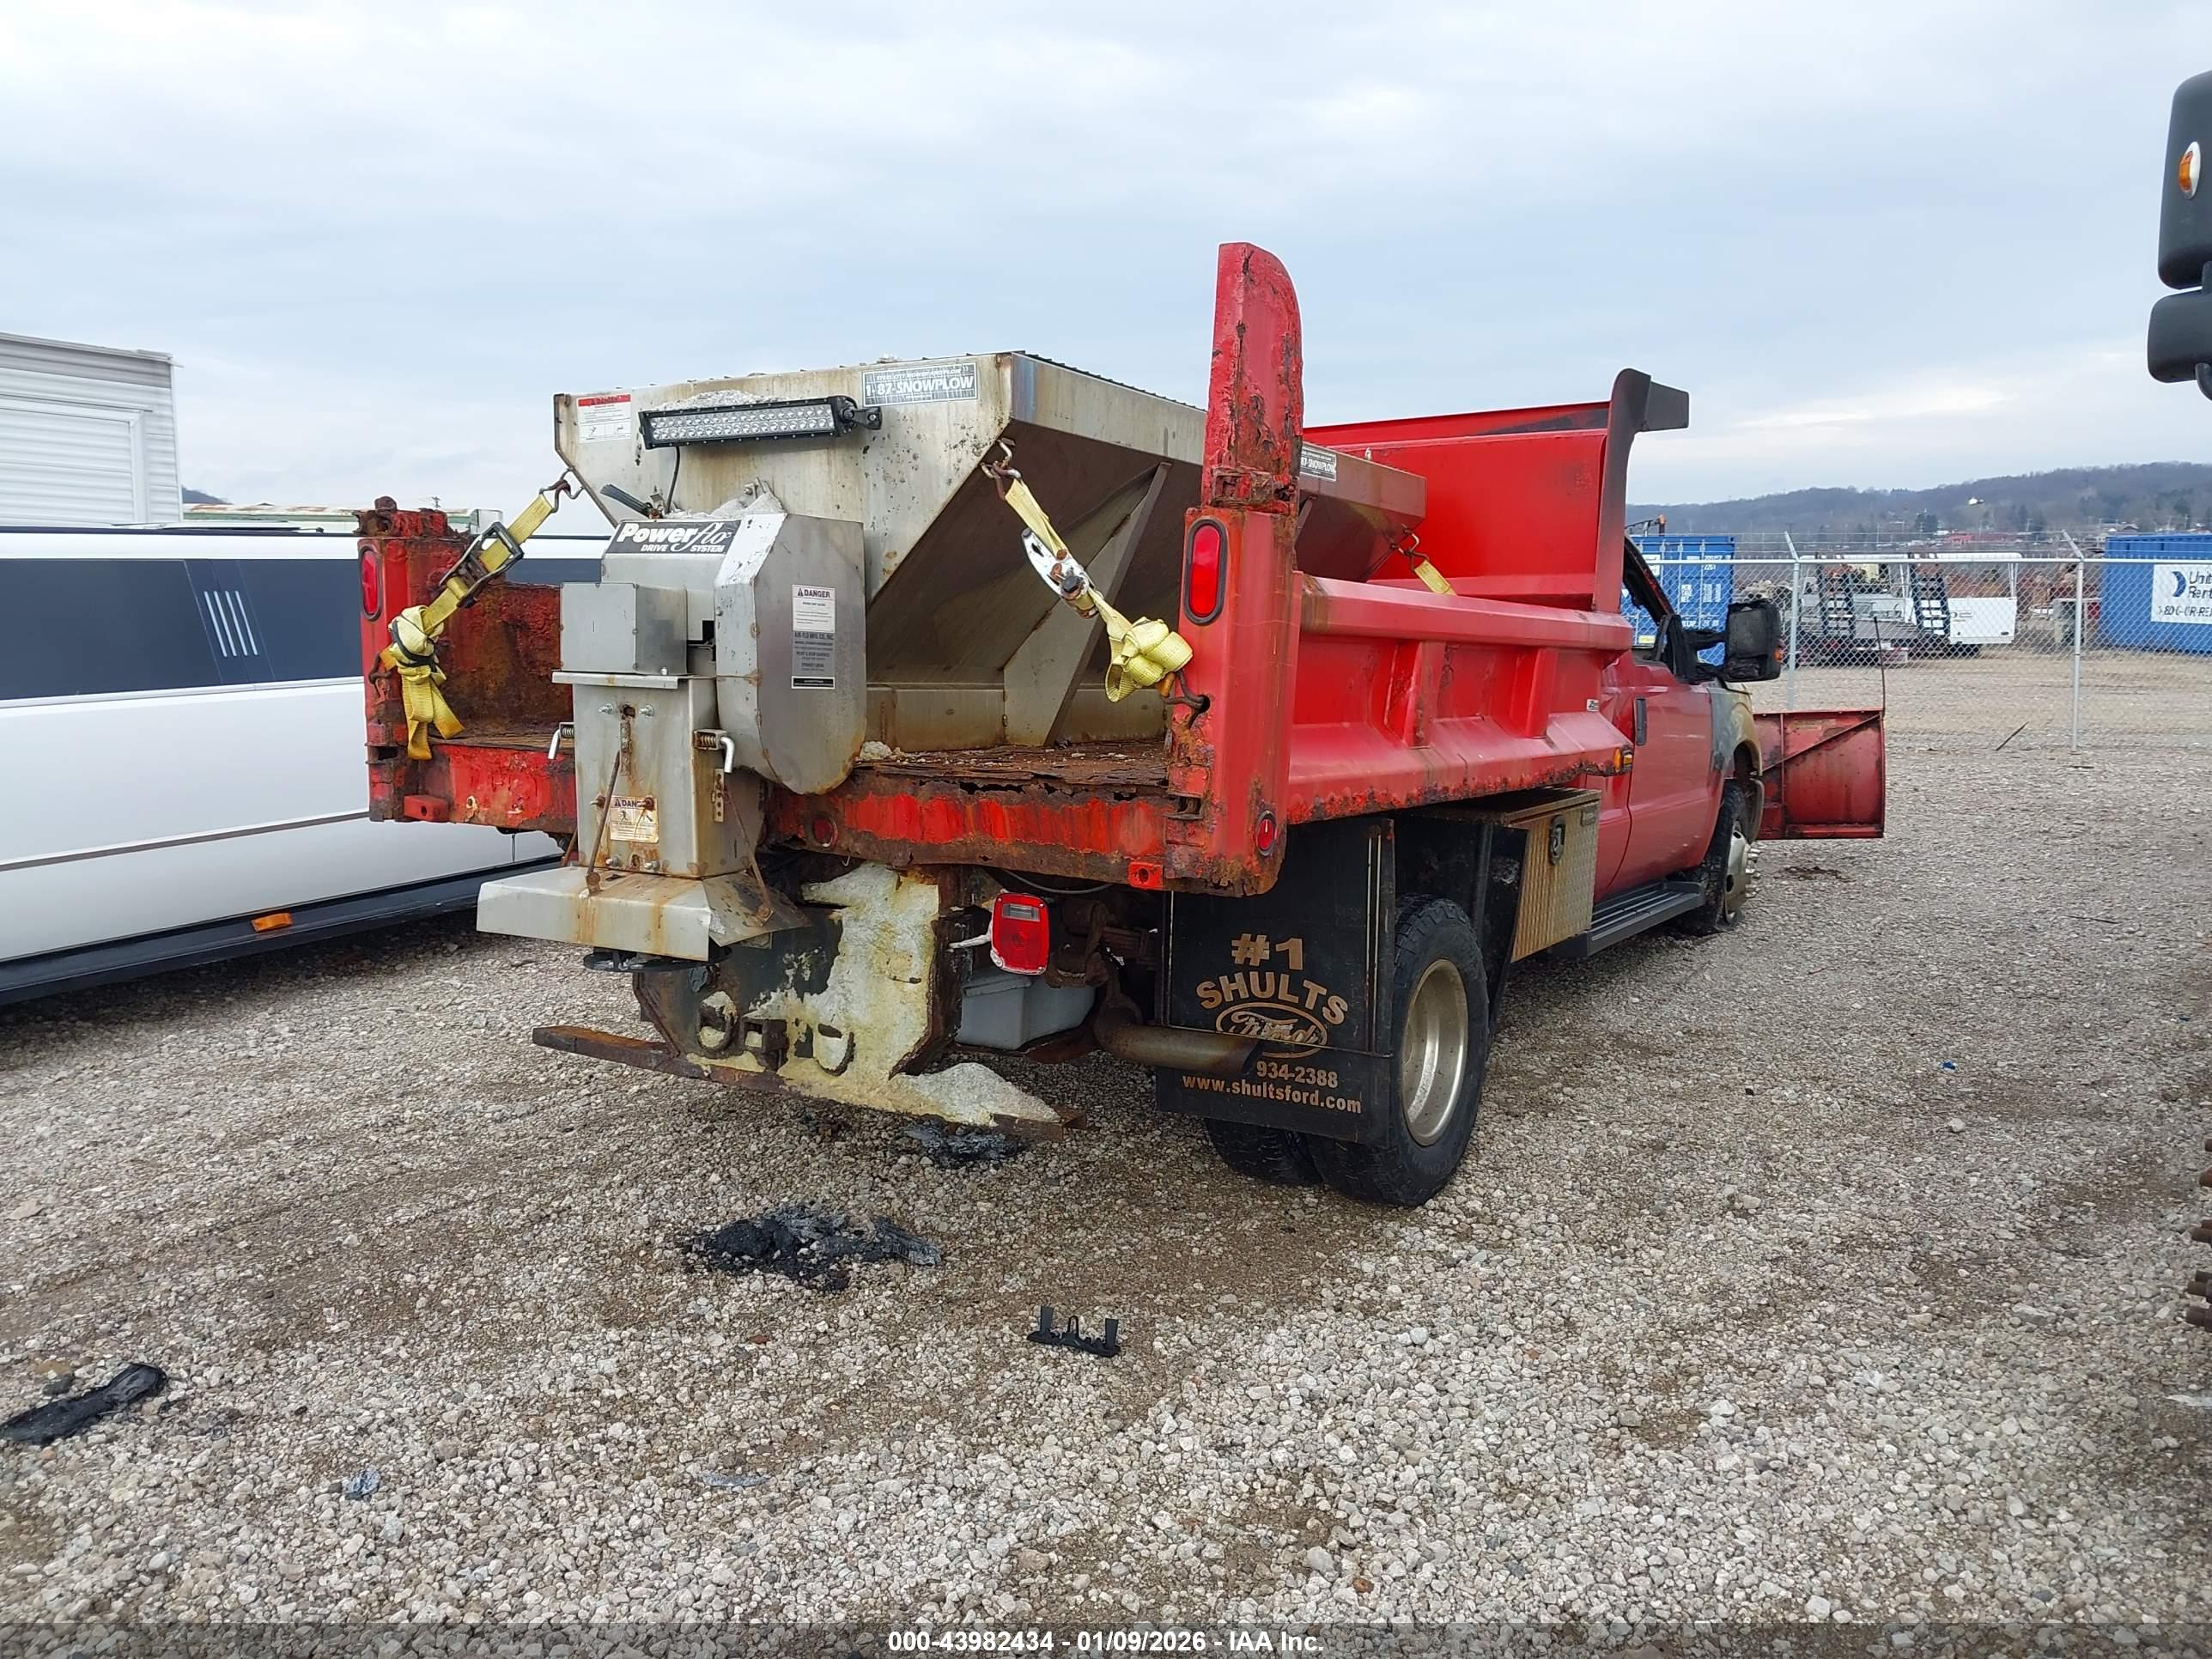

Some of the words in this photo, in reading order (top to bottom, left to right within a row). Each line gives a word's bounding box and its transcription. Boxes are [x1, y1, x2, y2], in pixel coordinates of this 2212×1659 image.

[690, 544, 725, 553] SYSTEM
[804, 588, 830, 599] DANGER
[1231, 933, 1304, 970] #1
[1196, 971, 1348, 1025] SHULTS
[1256, 1060, 1338, 1089] 934-2388
[1182, 1075, 1362, 1114] www.shultsford.com
